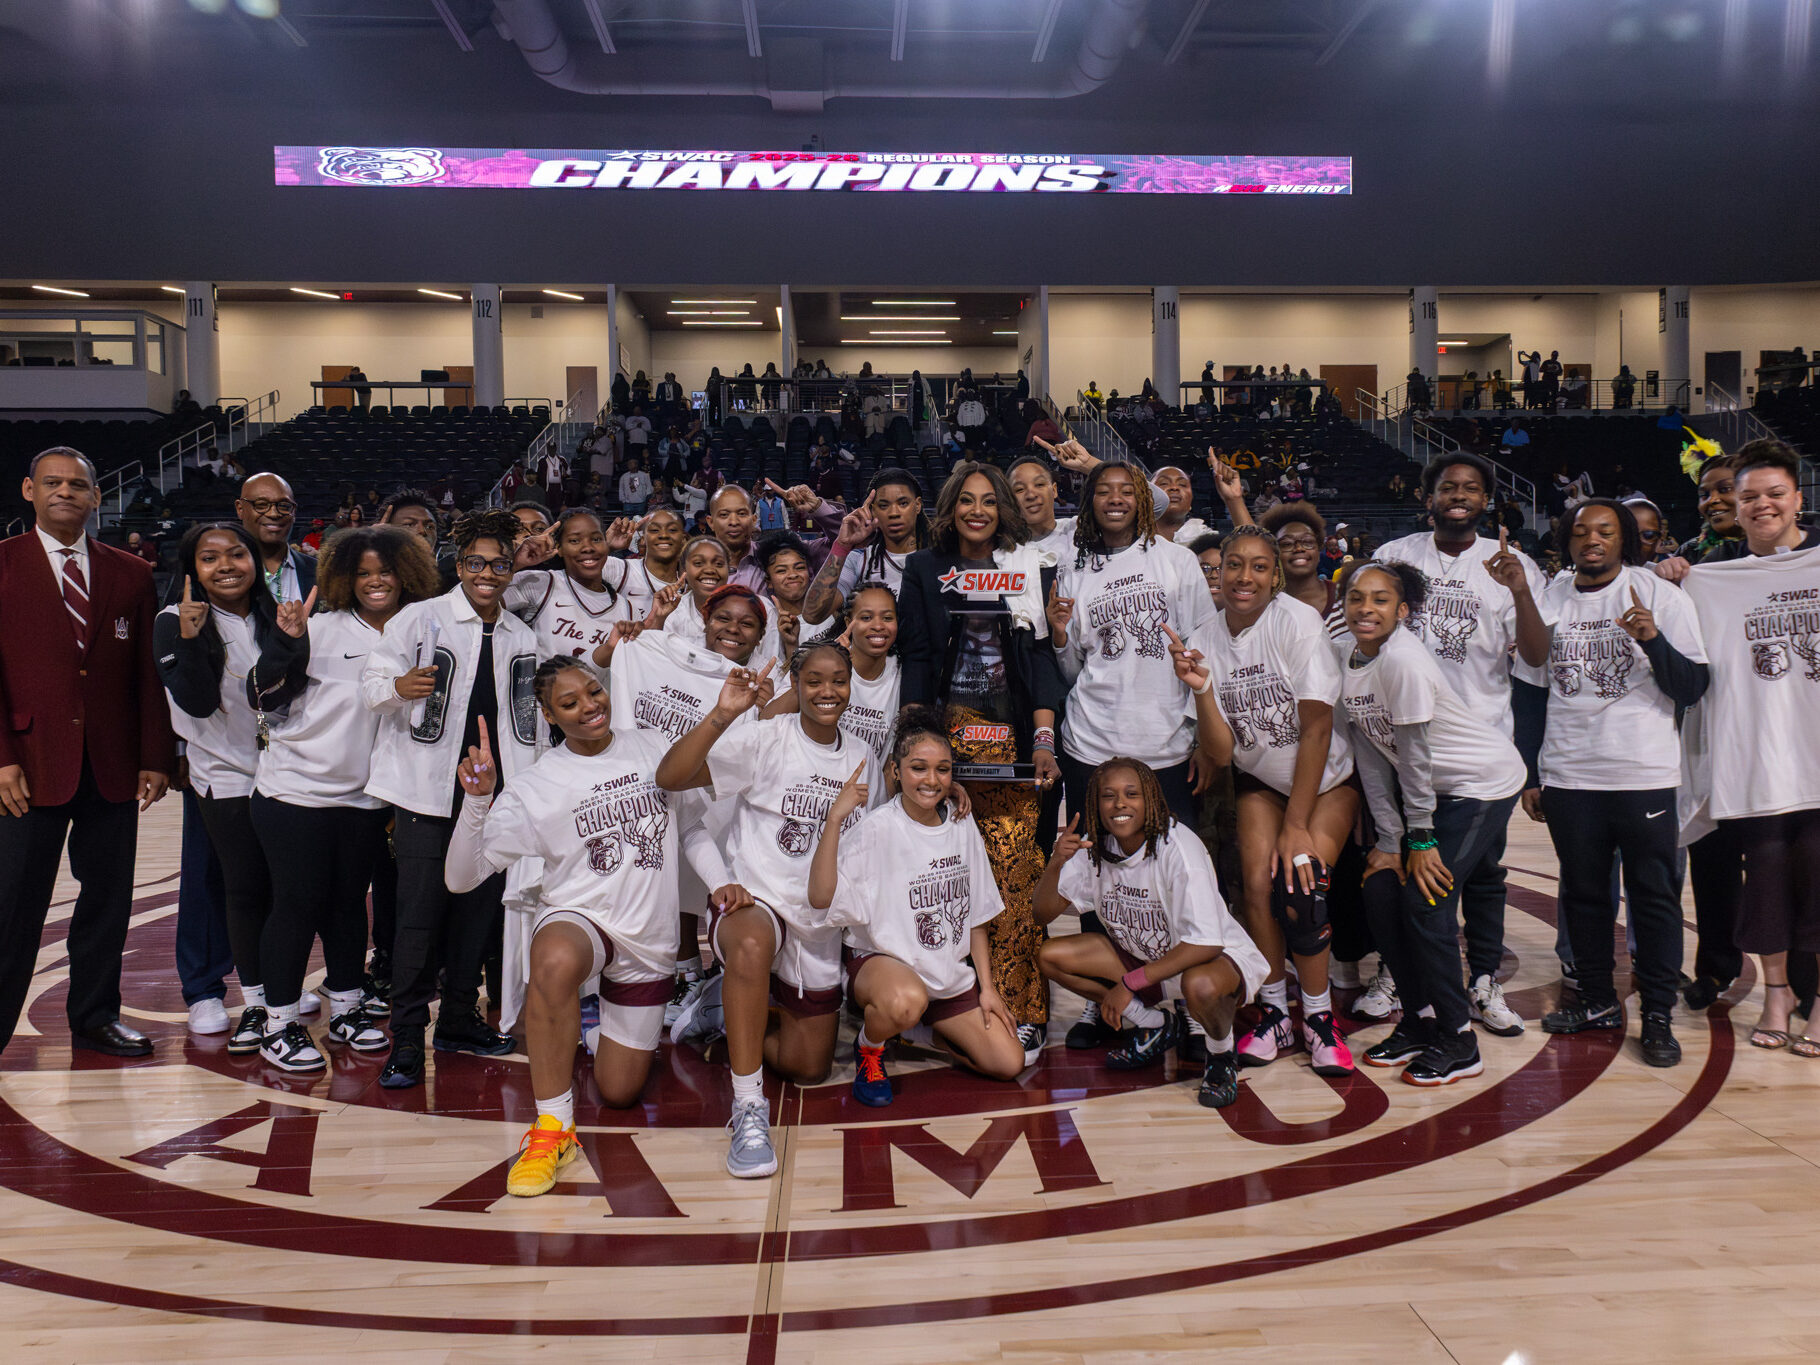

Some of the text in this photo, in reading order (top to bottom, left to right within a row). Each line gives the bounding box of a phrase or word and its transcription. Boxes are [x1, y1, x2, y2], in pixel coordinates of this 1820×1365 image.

[639, 152, 1071, 164] SWAC 2025-26 REGULAR SEASON
[529, 160, 1105, 190] CHAMPIONS
[189, 298, 203, 316] 111
[476, 299, 492, 317] 112
[1161, 302, 1176, 319] 114
[963, 573, 1025, 590] SWAC
[1114, 574, 1144, 588] SWAC
[1087, 594, 1117, 608] WOMEN'S
[1781, 588, 1818, 602] SWAC
[1089, 589, 1168, 628] CHAMPIONS
[1422, 595, 1480, 620] MPIONS
[1744, 608, 1785, 617] WOMEN'S
[552, 618, 610, 645] The H
[1580, 618, 1611, 630] SWAC
[1550, 636, 1633, 662] CHAMPIONS
[1239, 664, 1264, 678] SWAC
[1246, 677, 1280, 688] BASKETBA
[638, 691, 703, 720] WOMEN'S BASKETB
[670, 689, 702, 708] SWAC
[634, 696, 698, 736] CHAMPIO
[688, 706, 706, 717] SEASO
[854, 706, 884, 720] SWAC
[964, 726, 1008, 740] SWAC
[600, 788, 630, 798] REGULAR
[630, 780, 654, 788] SEASON
[604, 772, 640, 791] SWAC
[821, 777, 844, 790] SWA
[572, 784, 656, 814] WOMEN'S BASKETBA
[785, 787, 822, 796] WOMEN'S
[575, 788, 668, 838] CHAMPIONS
[940, 854, 962, 868] SWAC
[909, 875, 942, 886] WOMEN'S
[909, 875, 970, 910] CHAMPION
[1123, 886, 1149, 898] SWAC
[1126, 901, 1162, 909] BASKETBA
